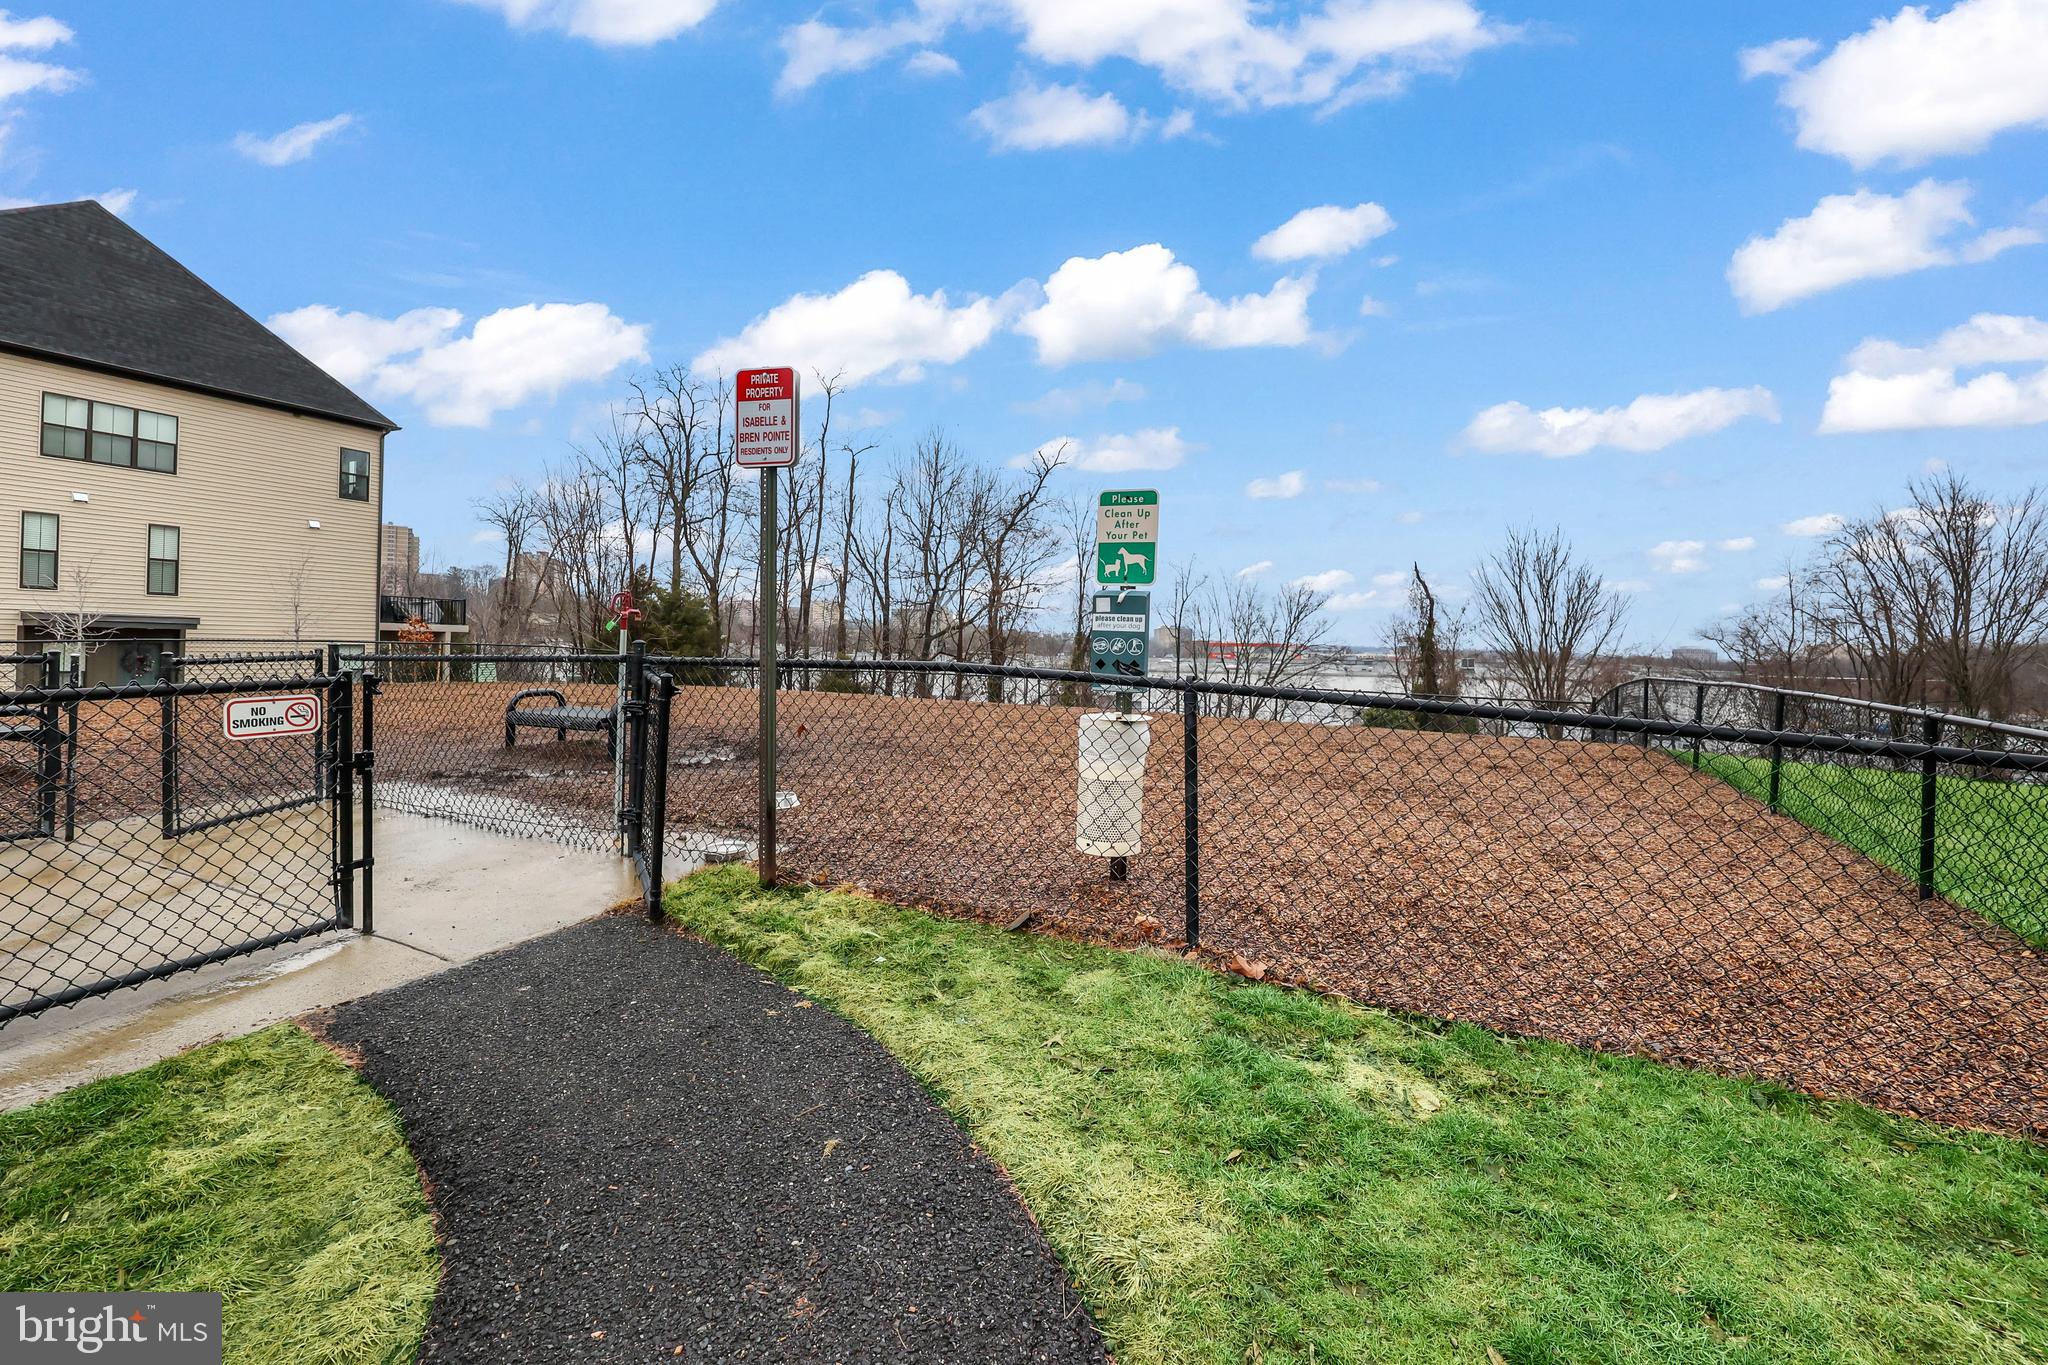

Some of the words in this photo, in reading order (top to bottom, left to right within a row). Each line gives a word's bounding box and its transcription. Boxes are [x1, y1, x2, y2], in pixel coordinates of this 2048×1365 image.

[745, 387, 784, 398] PROPERTY
[759, 403, 771, 411] FOR
[743, 416, 778, 428] ISABELLE
[781, 416, 786, 426] &
[740, 432, 760, 443] BREN
[763, 431, 790, 442] POINTE
[774, 446, 789, 454] ONLY
[1112, 494, 1145, 504] Please
[1104, 509, 1133, 518] Clean
[1137, 509, 1151, 519] Up
[1114, 520, 1140, 529] After
[1106, 531, 1128, 540] Your
[1132, 531, 1148, 540] Pet
[1128, 622, 1141, 630] dog
[250, 706, 267, 717] NO
[232, 716, 285, 729] SMOKING
